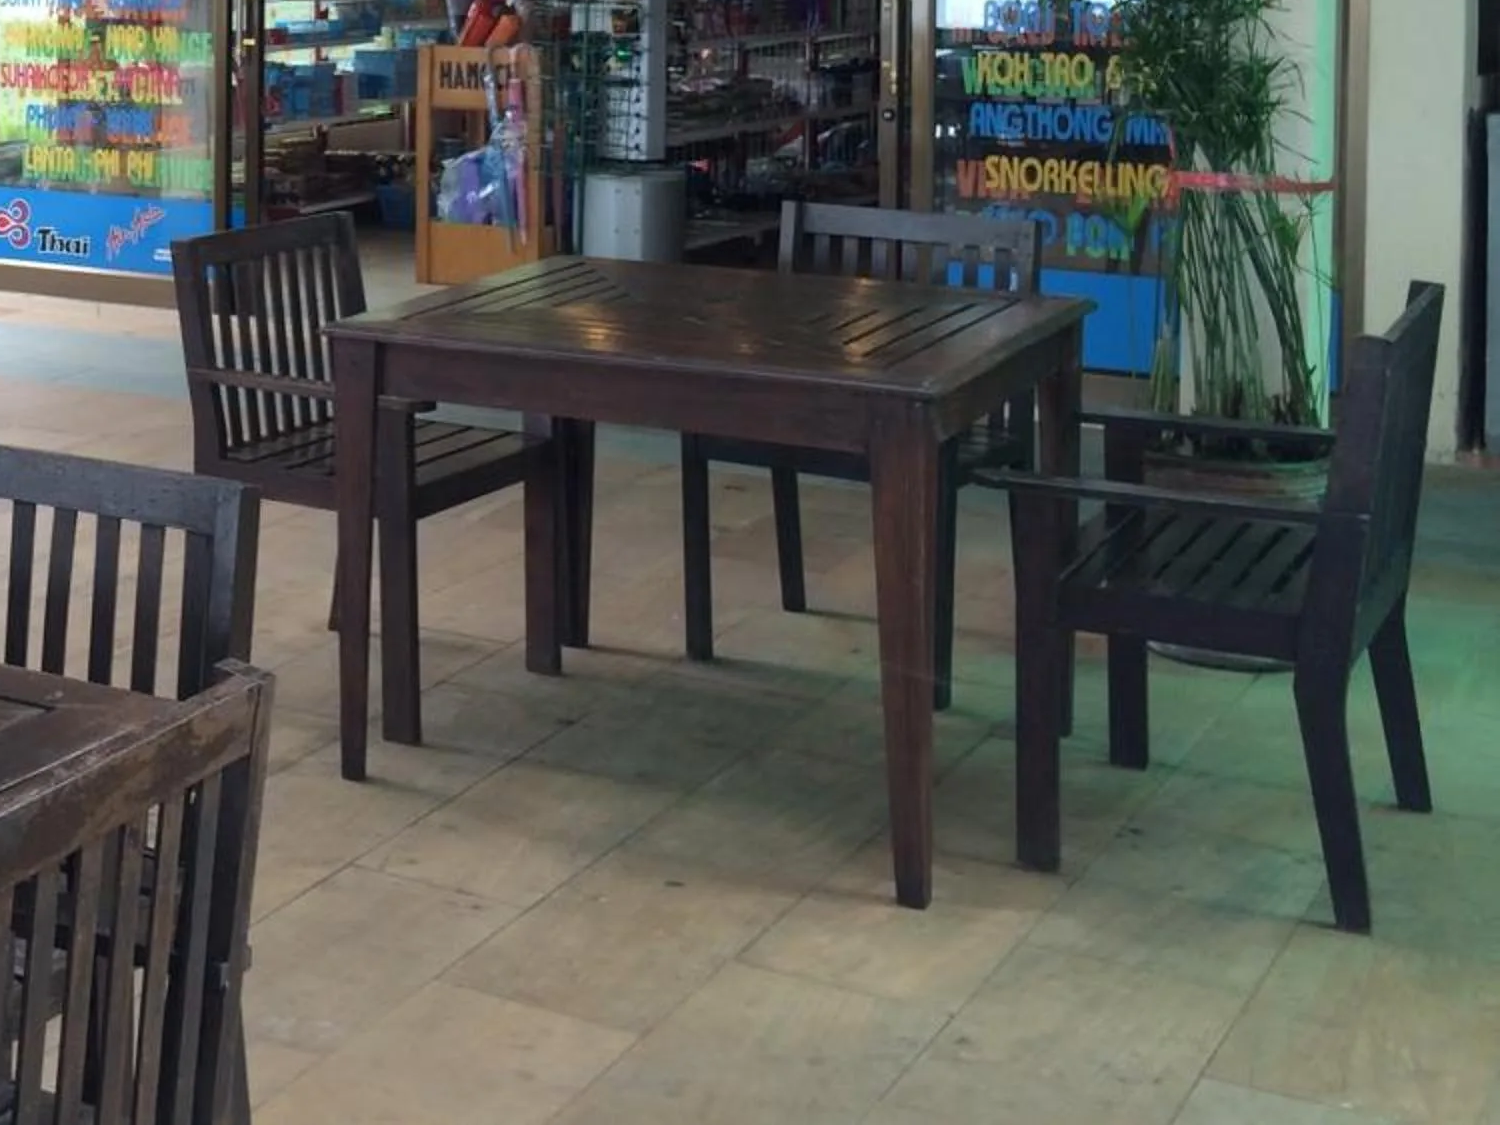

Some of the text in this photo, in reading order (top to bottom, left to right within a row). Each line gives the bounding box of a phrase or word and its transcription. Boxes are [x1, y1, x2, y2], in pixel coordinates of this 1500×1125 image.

[1040, 52, 1092, 90] TAO
[970, 102, 1114, 141] ANGTHONG
[985, 155, 1169, 198] SNORKELLING
[36, 227, 90, 257] Thai
